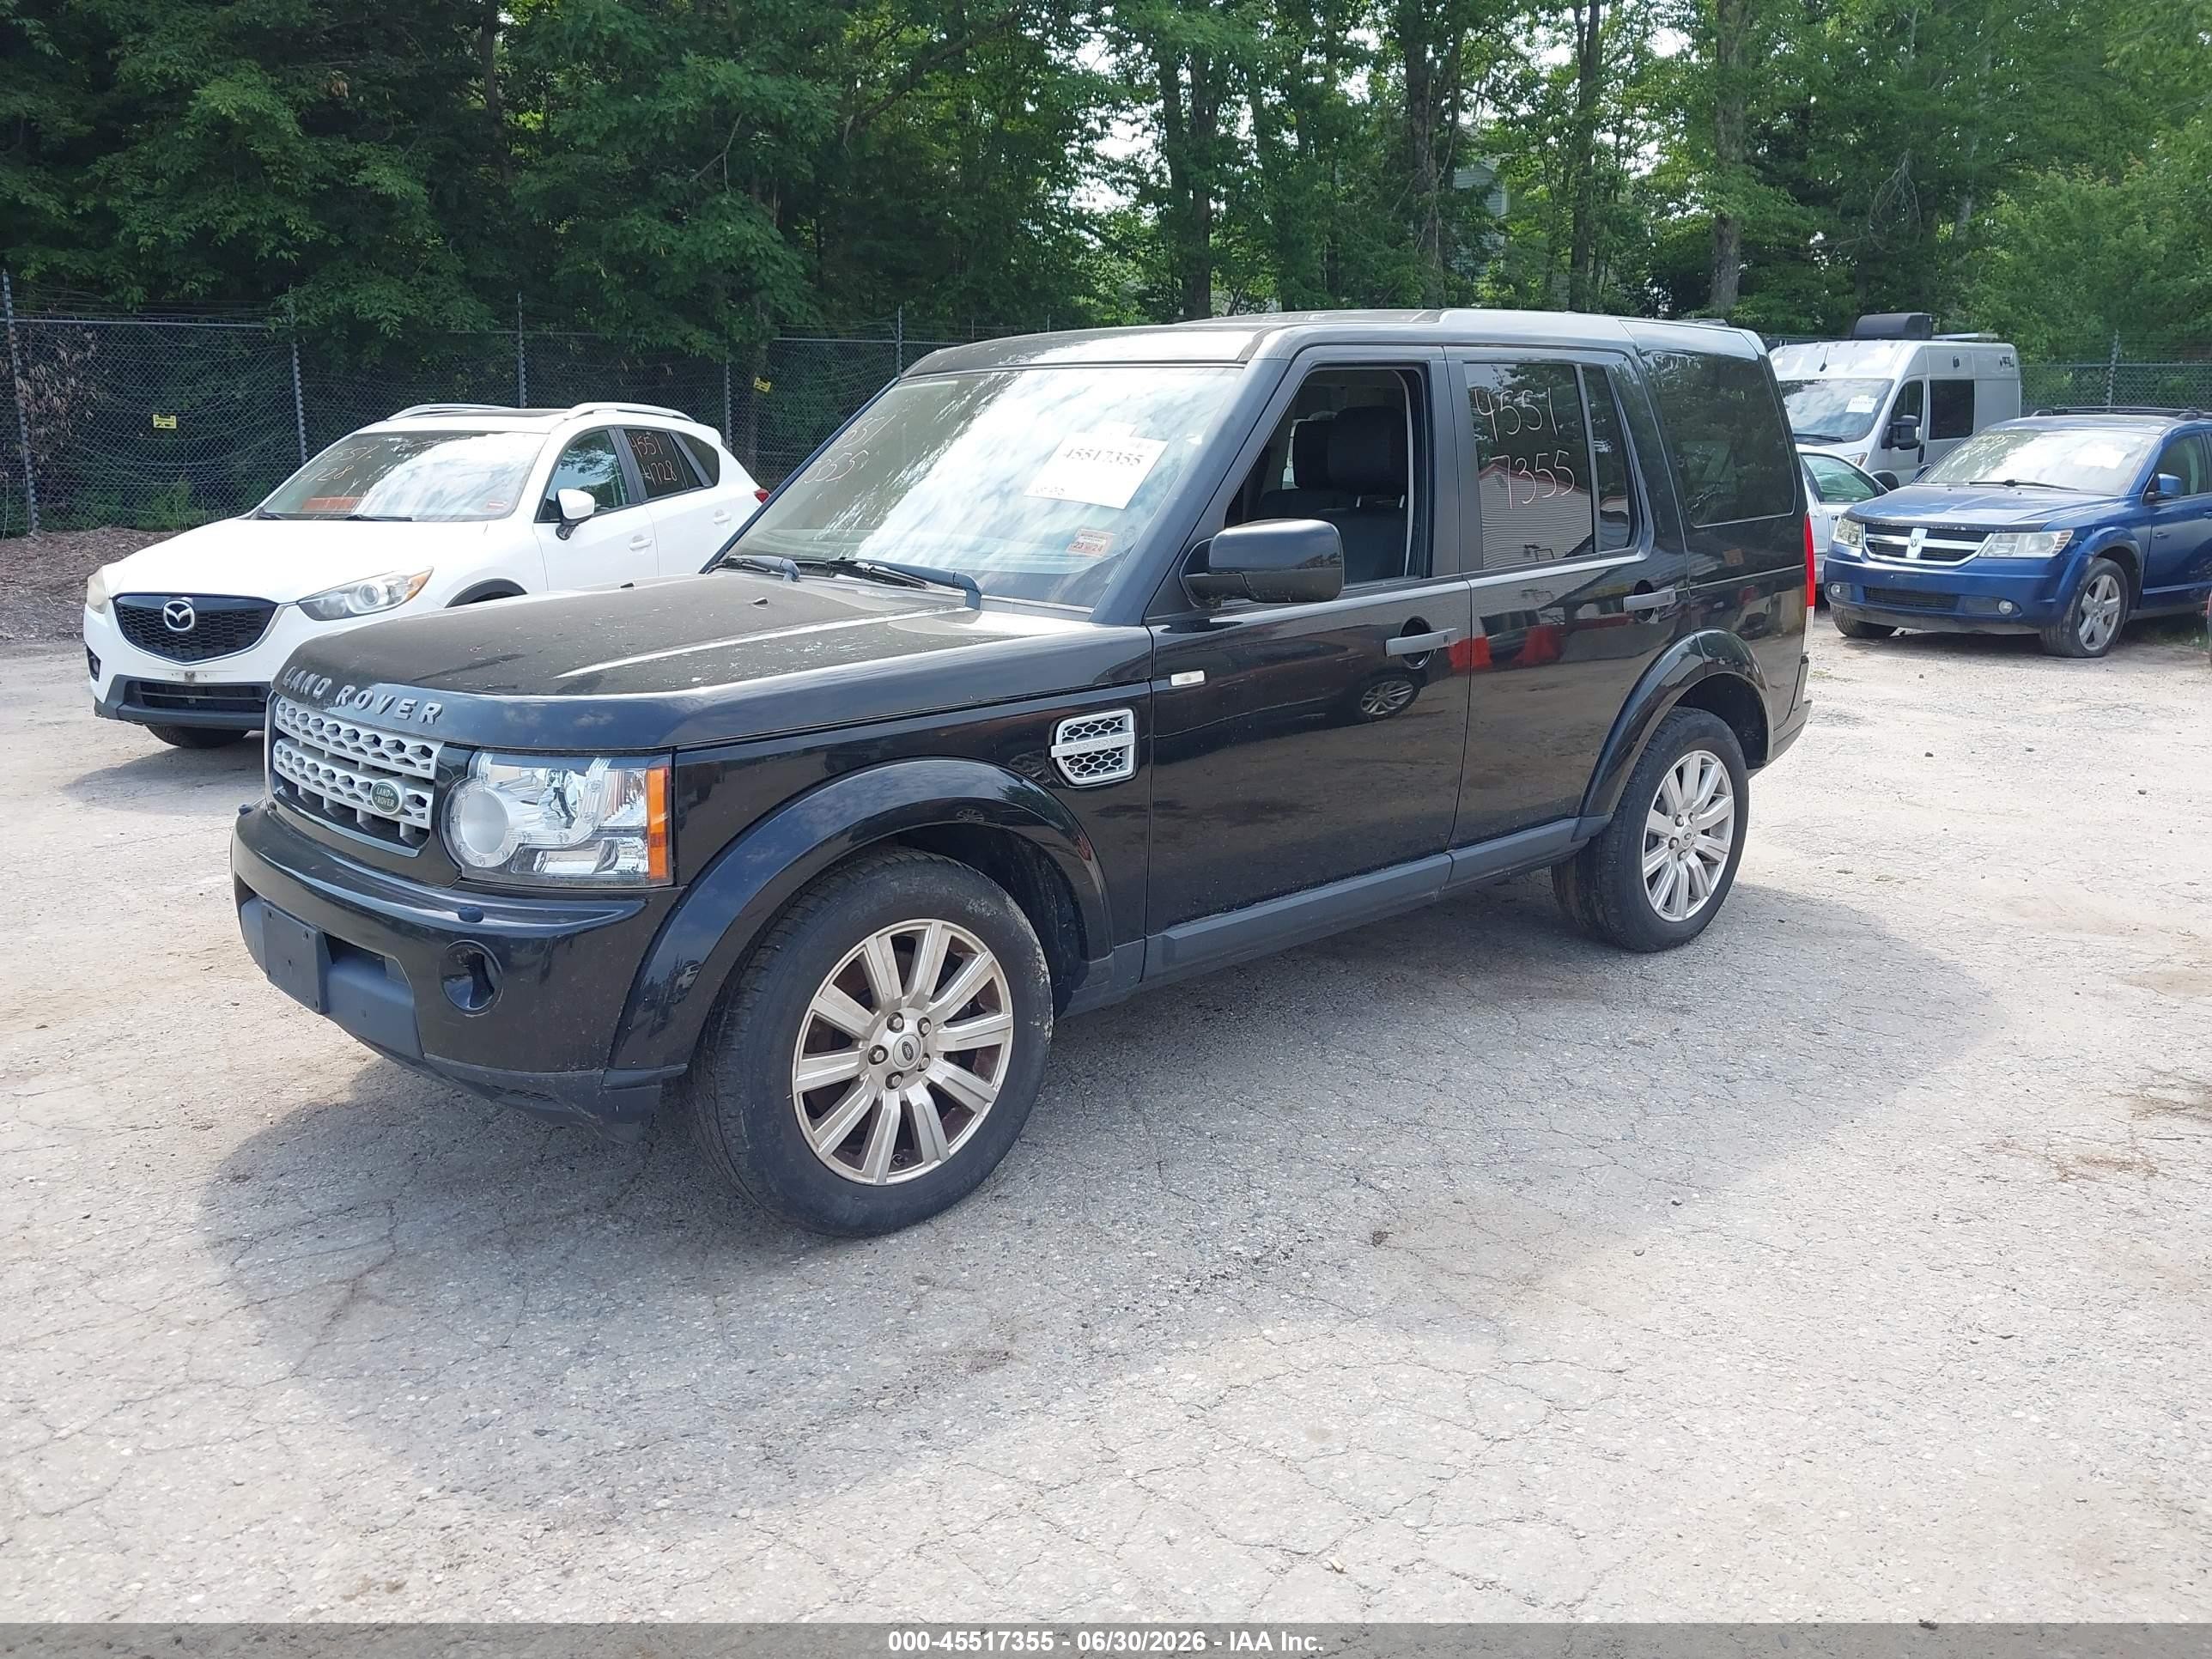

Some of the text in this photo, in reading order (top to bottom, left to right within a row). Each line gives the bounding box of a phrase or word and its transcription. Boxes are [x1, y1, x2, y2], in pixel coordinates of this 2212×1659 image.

[1473, 386, 1559, 442] 4551
[627, 434, 664, 459] 4551
[641, 459, 678, 488] 4728
[1491, 449, 1576, 510] 7355
[283, 665, 443, 725] LAND ROVER
[376, 787, 391, 798] LAND
[378, 796, 395, 808] ROVER
